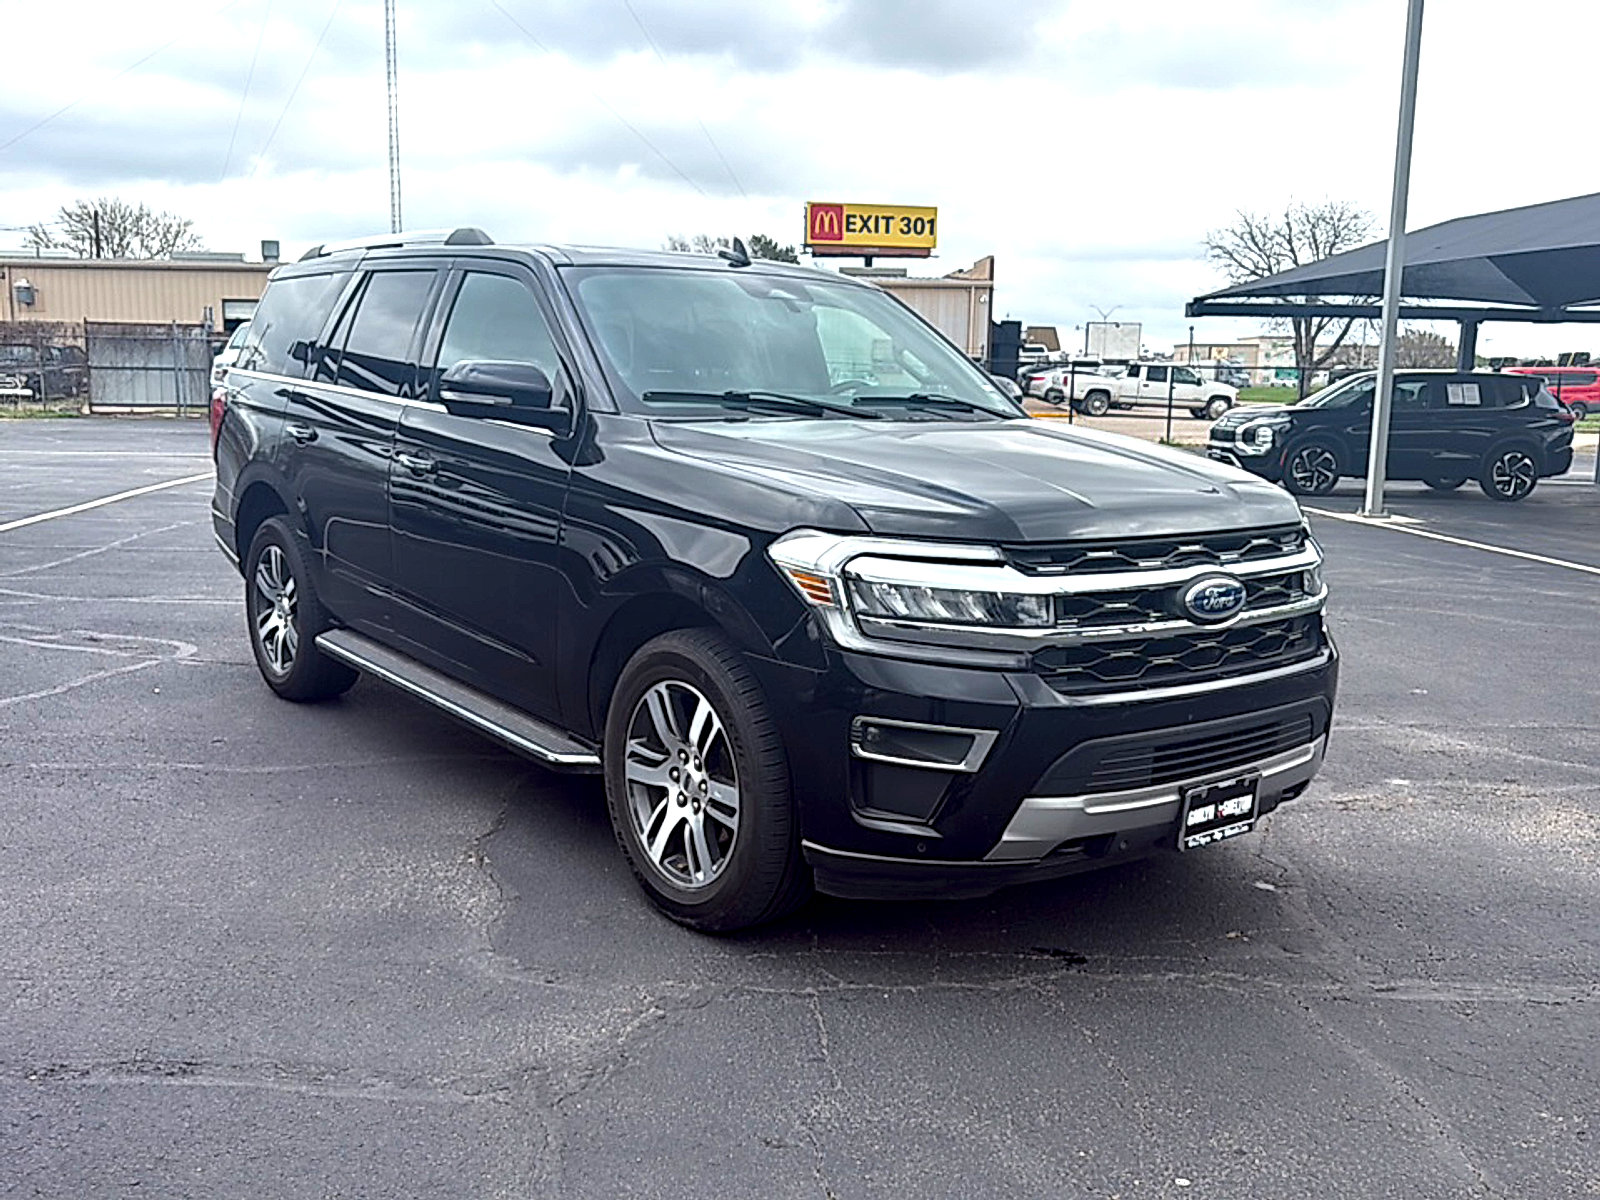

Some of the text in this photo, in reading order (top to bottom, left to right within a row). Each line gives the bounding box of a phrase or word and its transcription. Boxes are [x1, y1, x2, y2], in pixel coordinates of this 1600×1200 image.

[845, 213, 935, 236] EXIT 301
[1202, 586, 1236, 610] Ford
